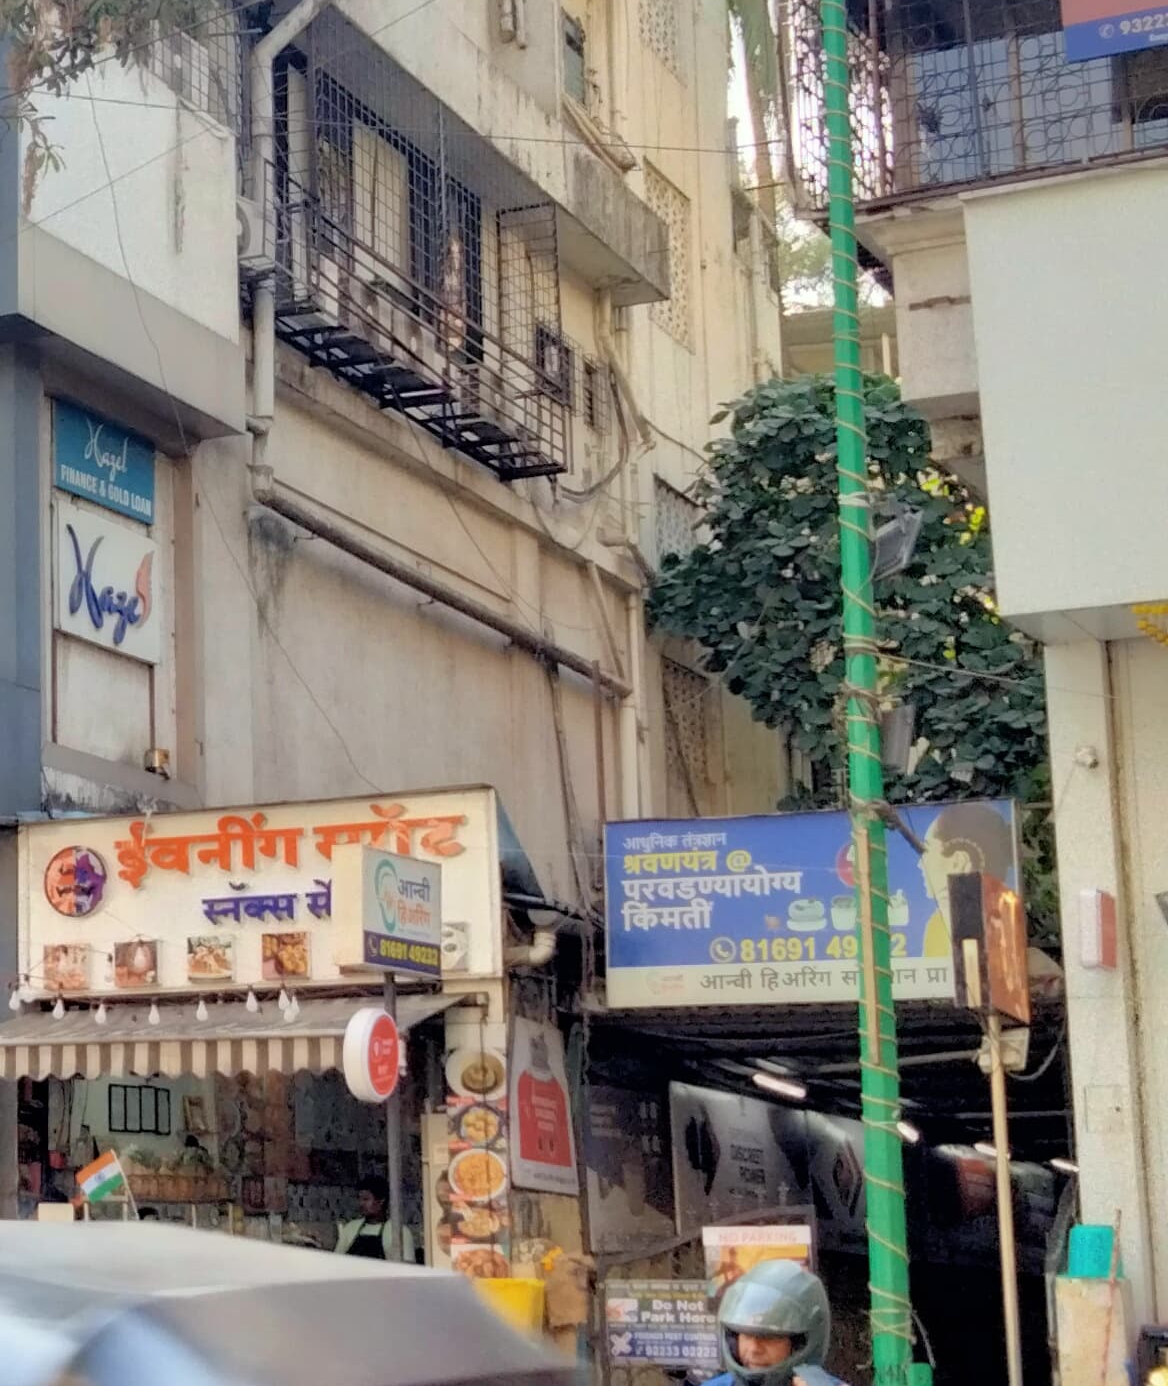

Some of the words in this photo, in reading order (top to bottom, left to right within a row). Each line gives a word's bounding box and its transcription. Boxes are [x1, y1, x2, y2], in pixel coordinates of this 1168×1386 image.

[60, 463, 97, 495] FINANCE
[99, 479, 107, 498] &
[108, 483, 130, 508] GOLD
[131, 494, 152, 518] LOAN
[623, 847, 719, 875] श्रवणयंत्र
[726, 849, 752, 872] @
[621, 865, 803, 901] परवडण्यायोग्य
[739, 936, 816, 962] 81691
[826, 935, 907, 959] 492
[741, 1229, 797, 1244] PARKING
[641, 1311, 675, 1323] Park
[652, 1299, 673, 1311] Do
[677, 1300, 704, 1312] Not
